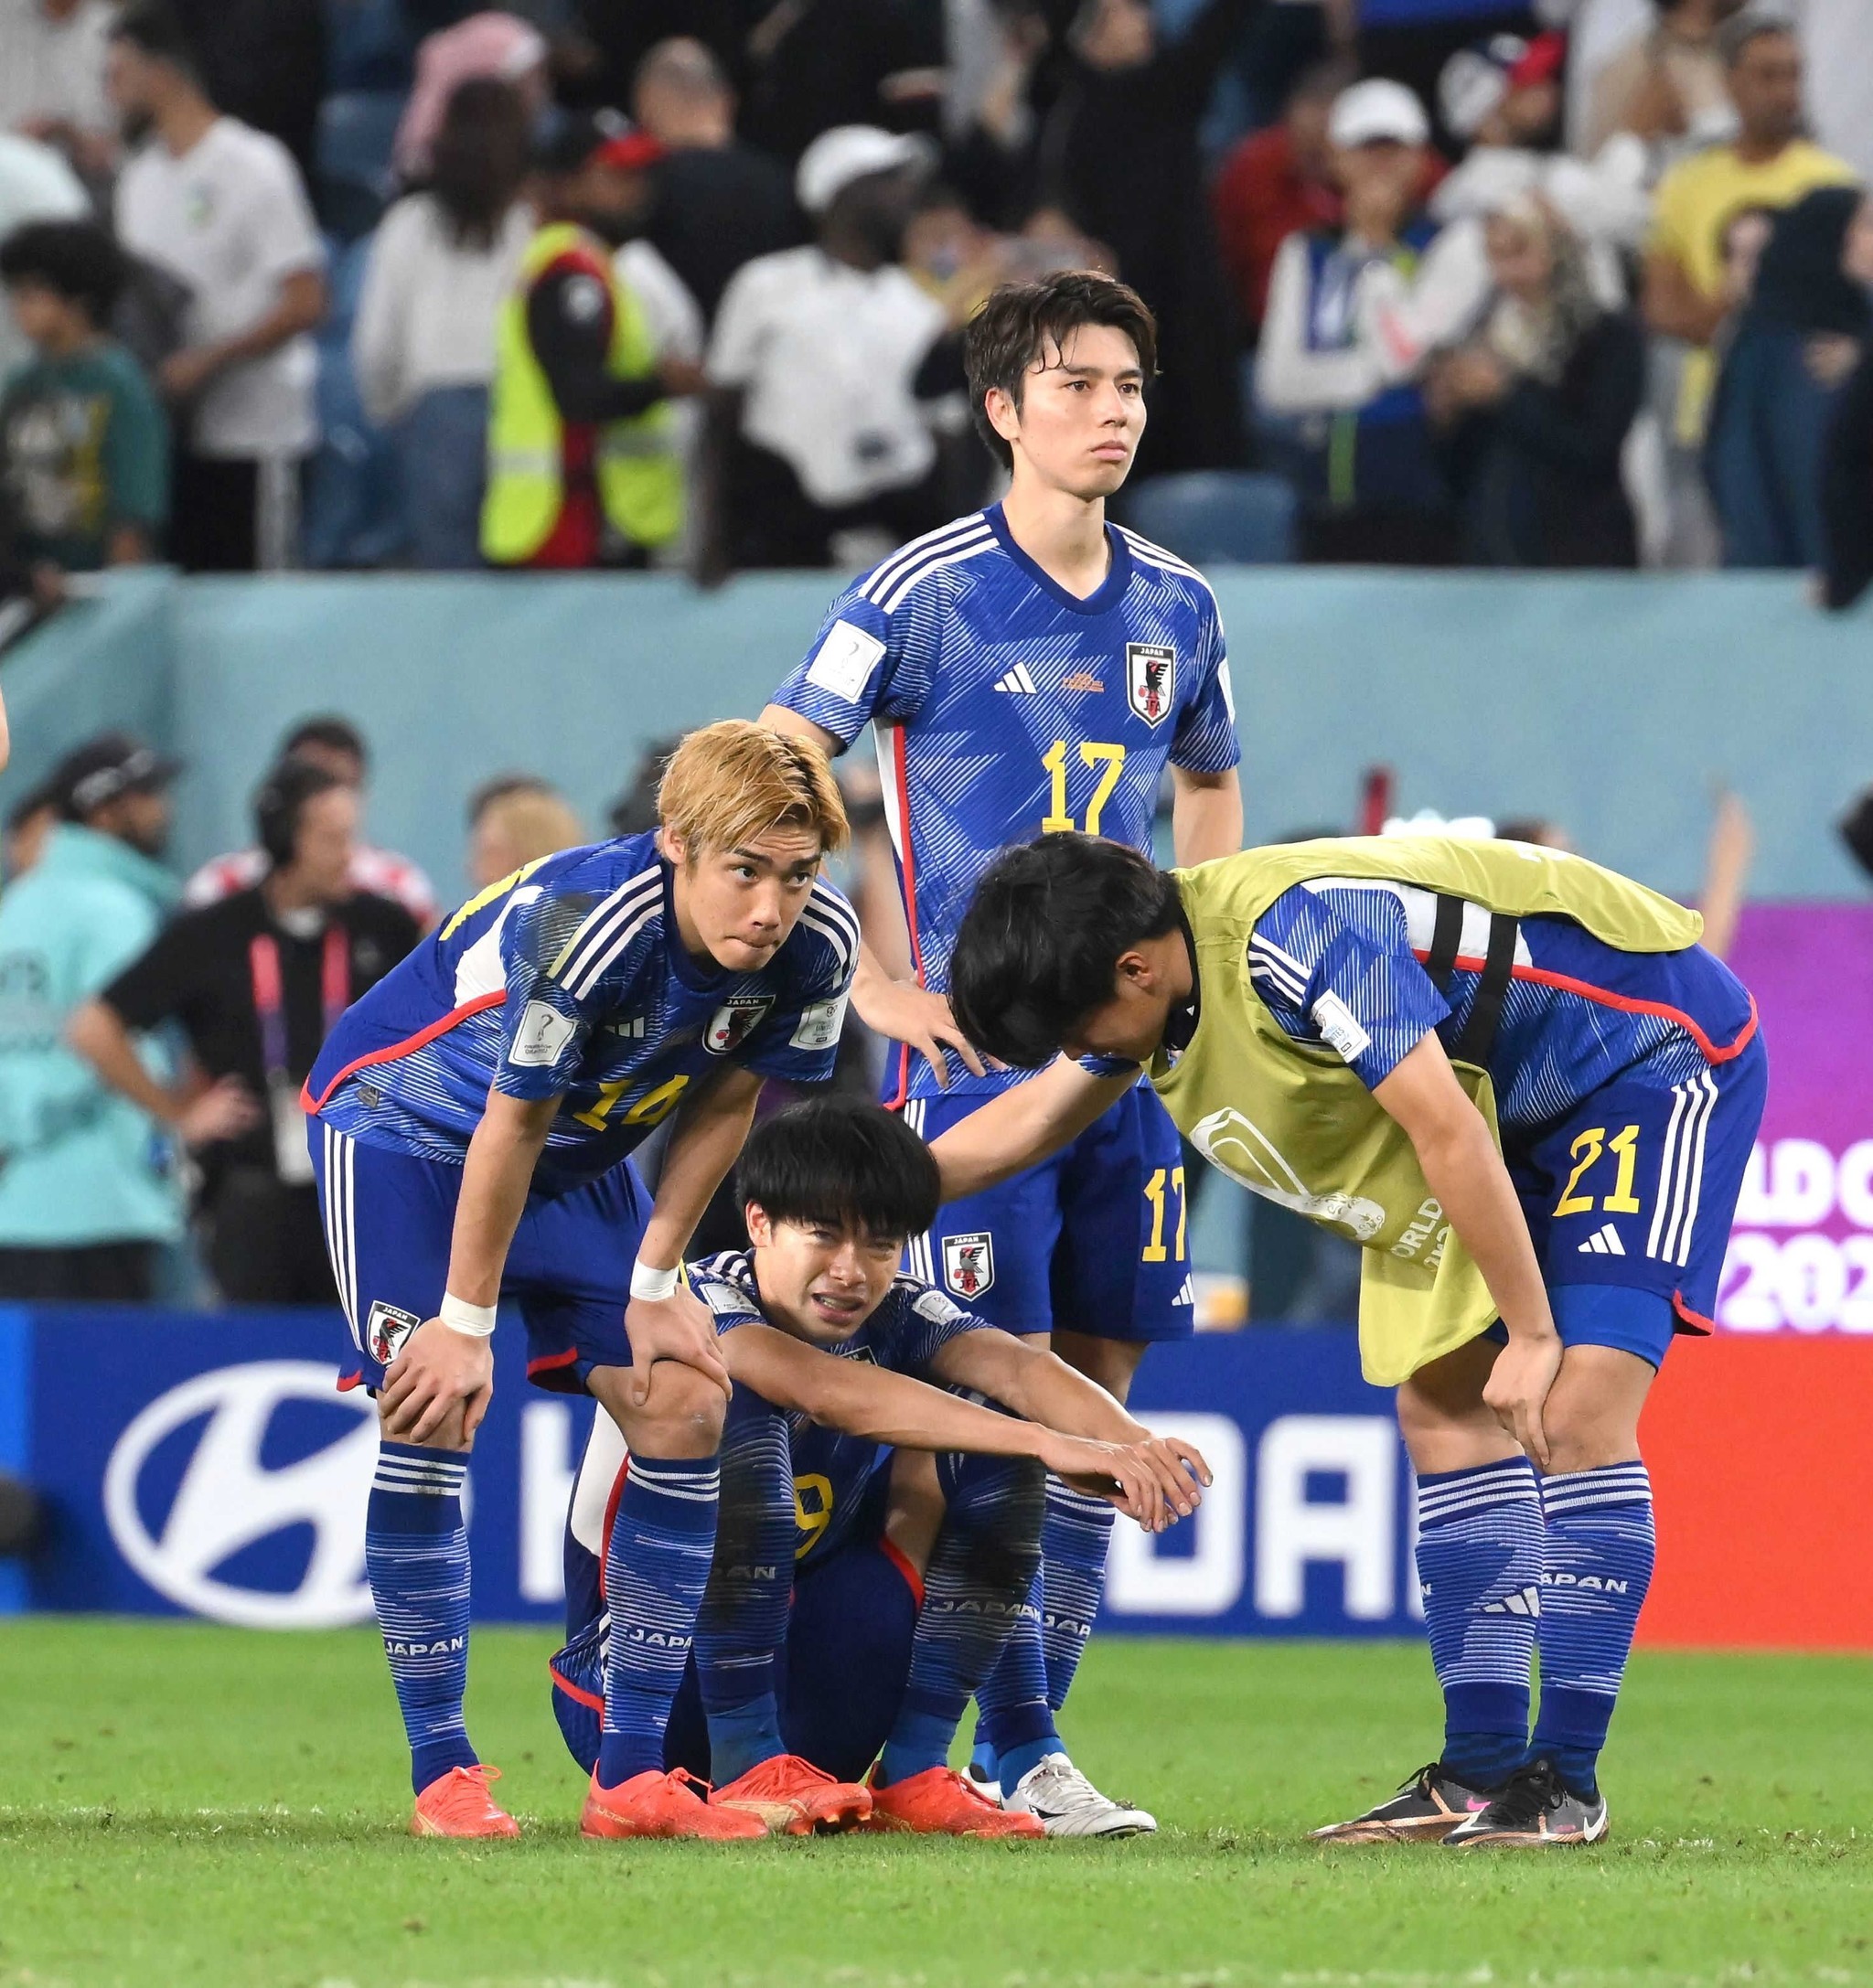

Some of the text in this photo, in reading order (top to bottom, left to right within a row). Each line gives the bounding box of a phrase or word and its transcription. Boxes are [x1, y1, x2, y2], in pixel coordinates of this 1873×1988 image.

[1140, 647, 1164, 657] JAPAN
[1042, 740, 1126, 837] 17
[573, 1074, 690, 1132] 14
[1551, 1125, 1640, 1217] 21
[953, 1235, 979, 1245] JAPAN
[1141, 1166, 1187, 1263] 17
[1390, 1197, 1443, 1259] ORLD
[382, 1307, 408, 1320] JAPAN
[793, 1472, 834, 1560] 9
[1540, 1572, 1629, 1594] APAN
[385, 1635, 464, 1656] JAPAN
